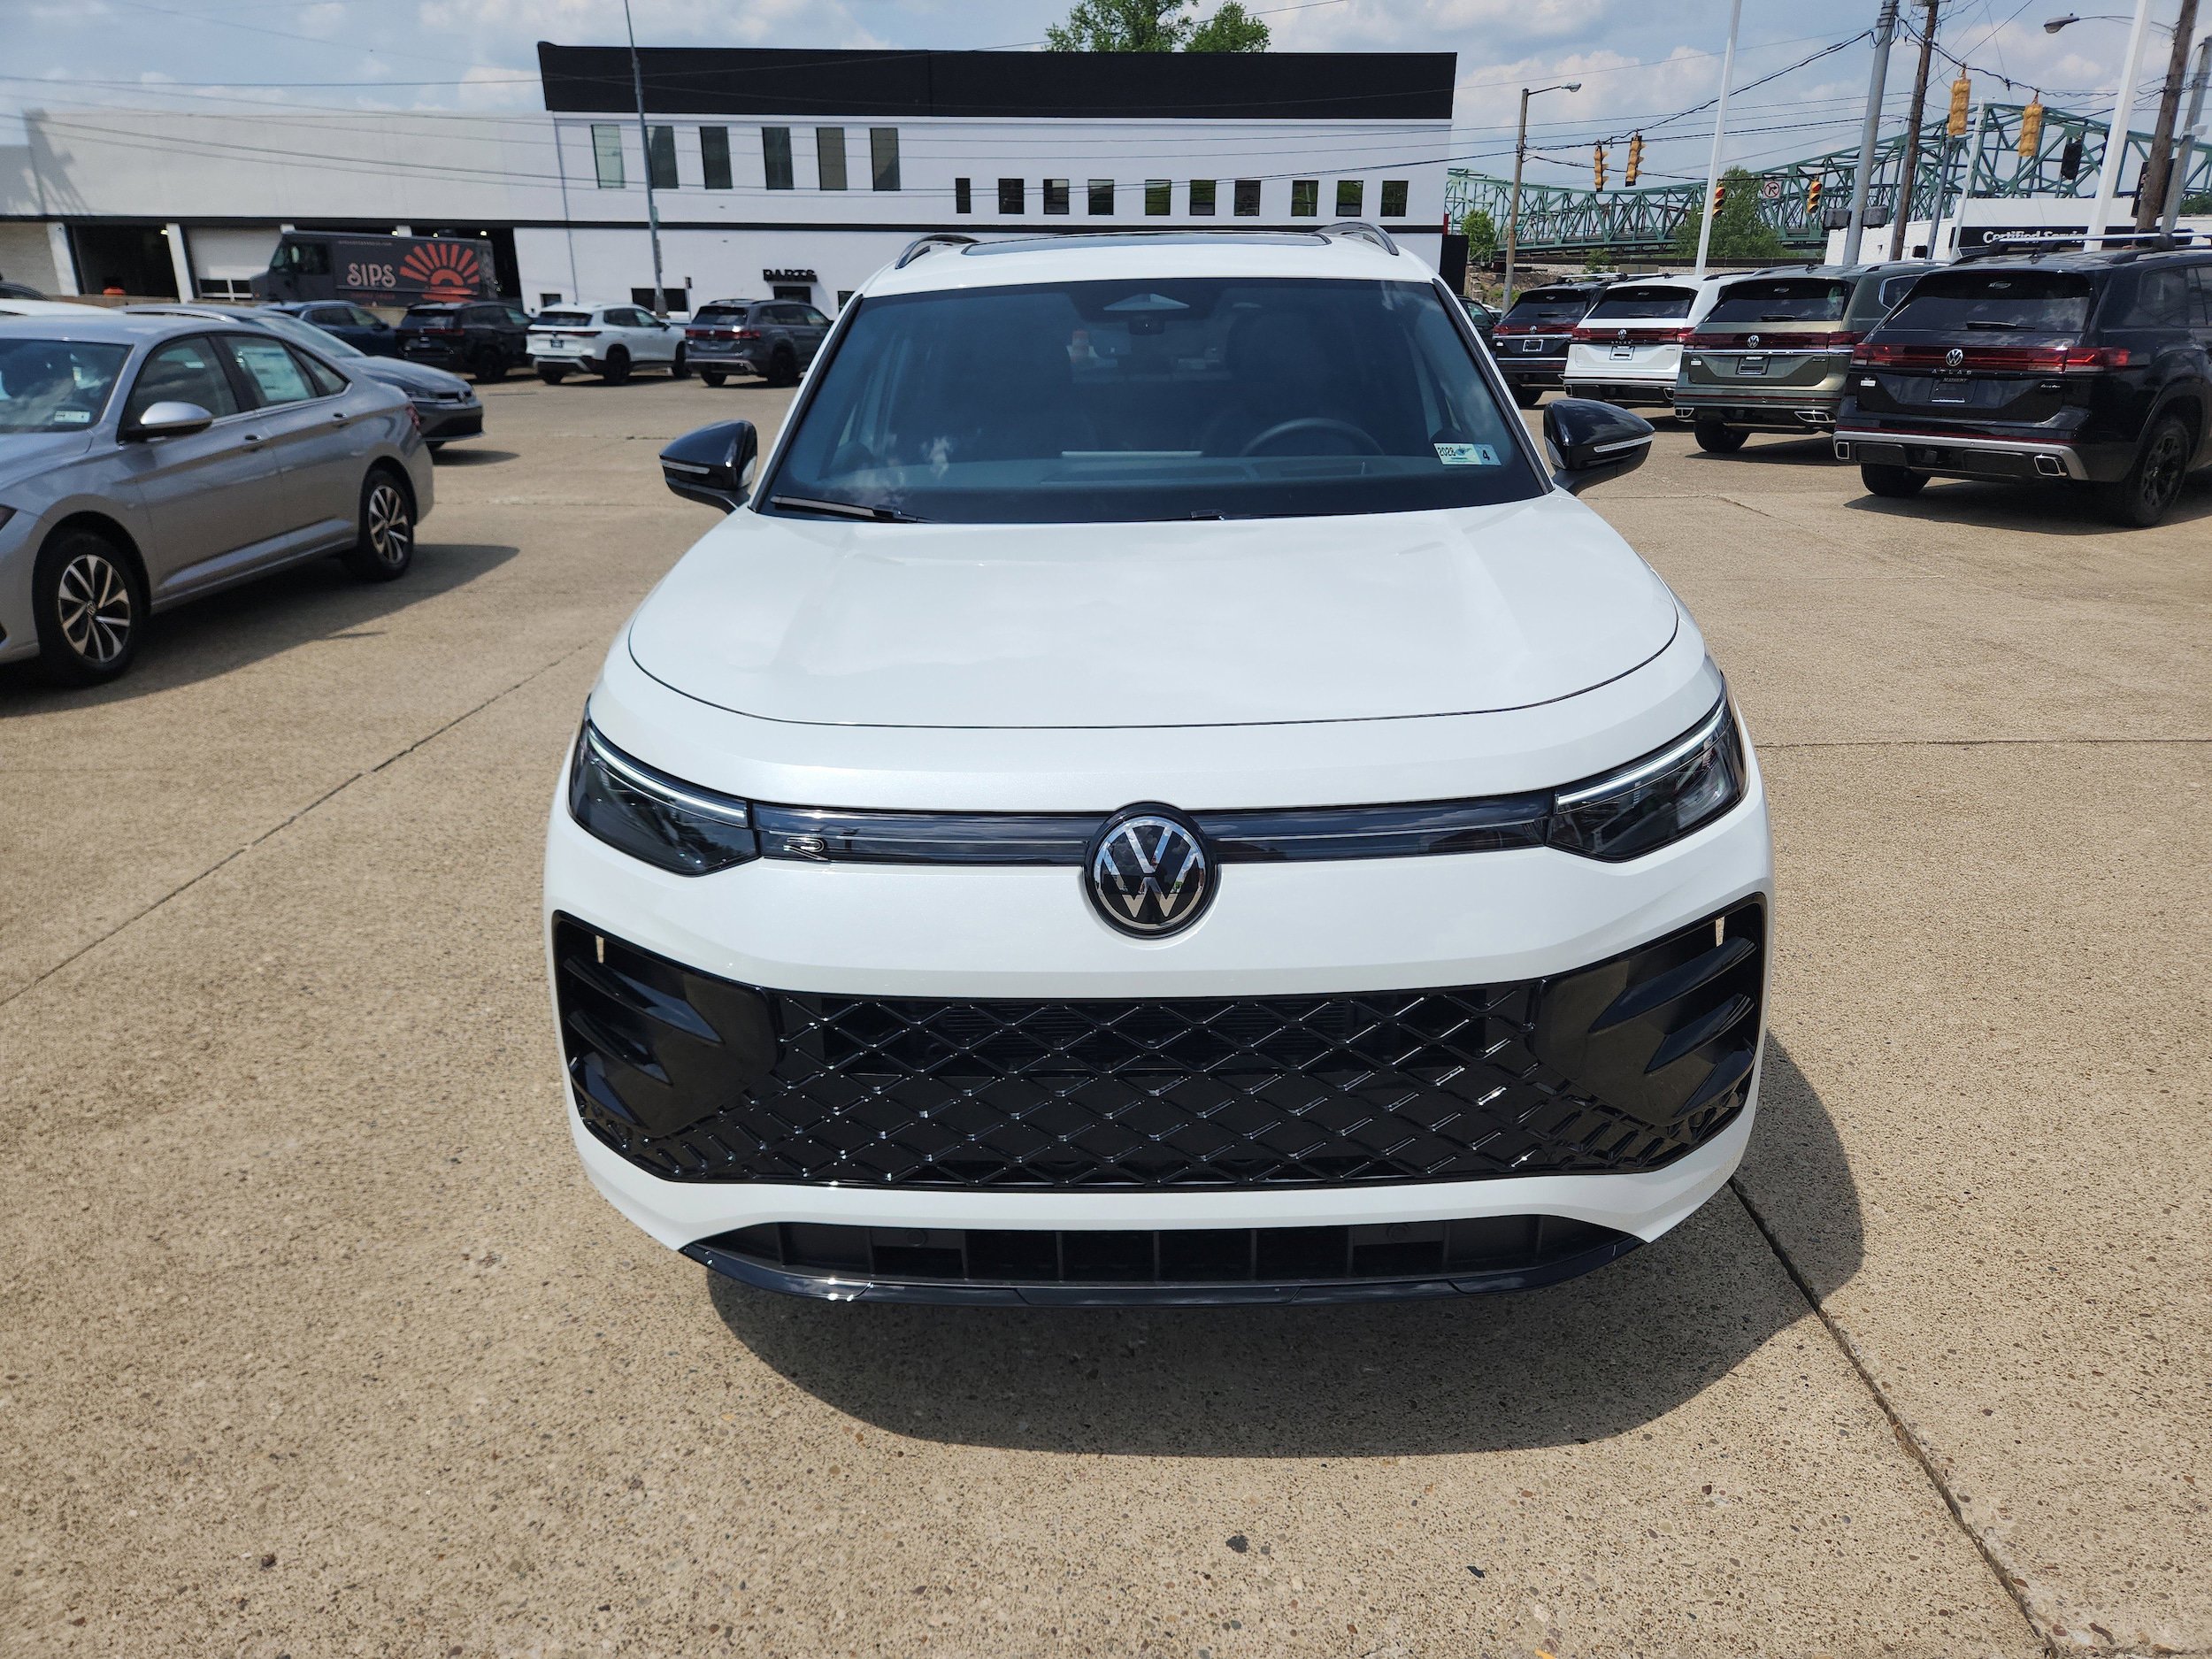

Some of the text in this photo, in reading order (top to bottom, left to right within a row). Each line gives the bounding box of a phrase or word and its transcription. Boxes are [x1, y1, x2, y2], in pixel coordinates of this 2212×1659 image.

[346, 263, 397, 288] SIPS
[763, 269, 818, 281] PARTS
[1482, 449, 1491, 461] 4
